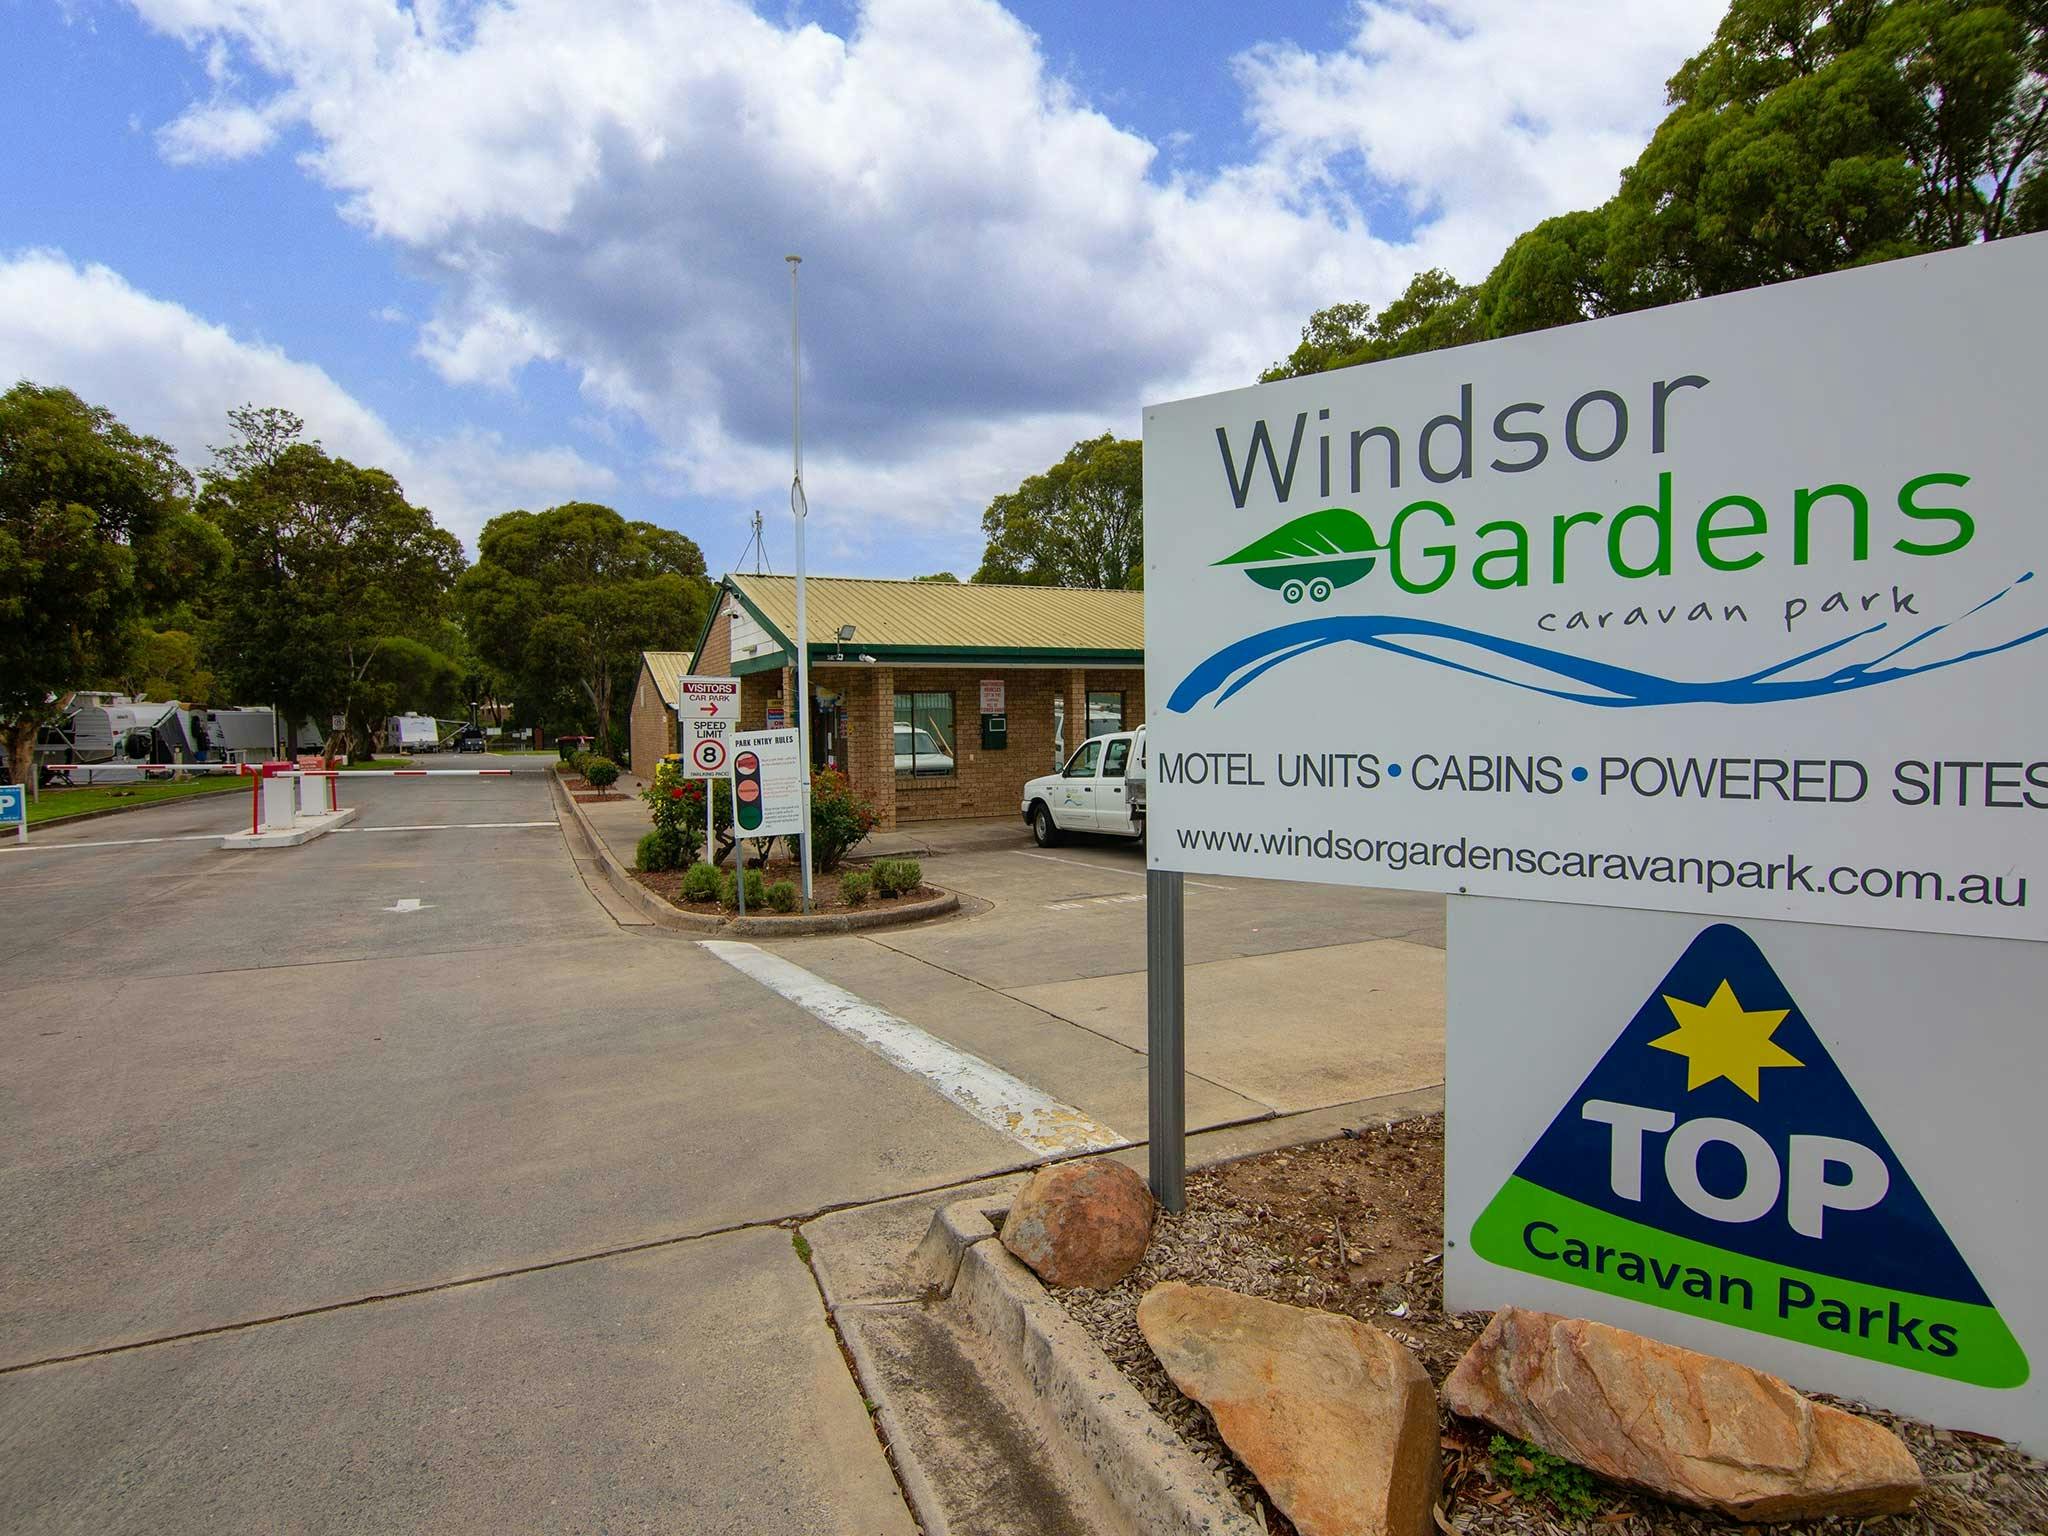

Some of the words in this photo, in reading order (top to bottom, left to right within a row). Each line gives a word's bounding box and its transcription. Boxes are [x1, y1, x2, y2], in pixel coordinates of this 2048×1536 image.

[1215, 375, 1710, 509] Windsor
[1389, 472, 1976, 596] Gardens
[1537, 599, 1749, 633] caravan
[1784, 585, 1920, 633] park
[687, 683, 732, 693] VISITORS
[693, 721, 727, 730] SPEED
[696, 730, 723, 739] LIMIT
[735, 739, 751, 747] PARK
[753, 737, 773, 746] ENTRY
[775, 735, 794, 744] RULES
[703, 747, 716, 762] 8
[1158, 752, 1265, 787] MOTEL
[1277, 753, 1381, 789] UNITS
[1411, 754, 1563, 796] CABINS
[1600, 757, 1869, 804] POWERED
[1892, 760, 2048, 809] SITES
[1177, 827, 2027, 907] www.windsorgardenscaravanpark.com.au
[1582, 1099, 1890, 1240] TOP
[1522, 1220, 1754, 1311] Caravan
[1778, 1276, 1960, 1359] Parks
